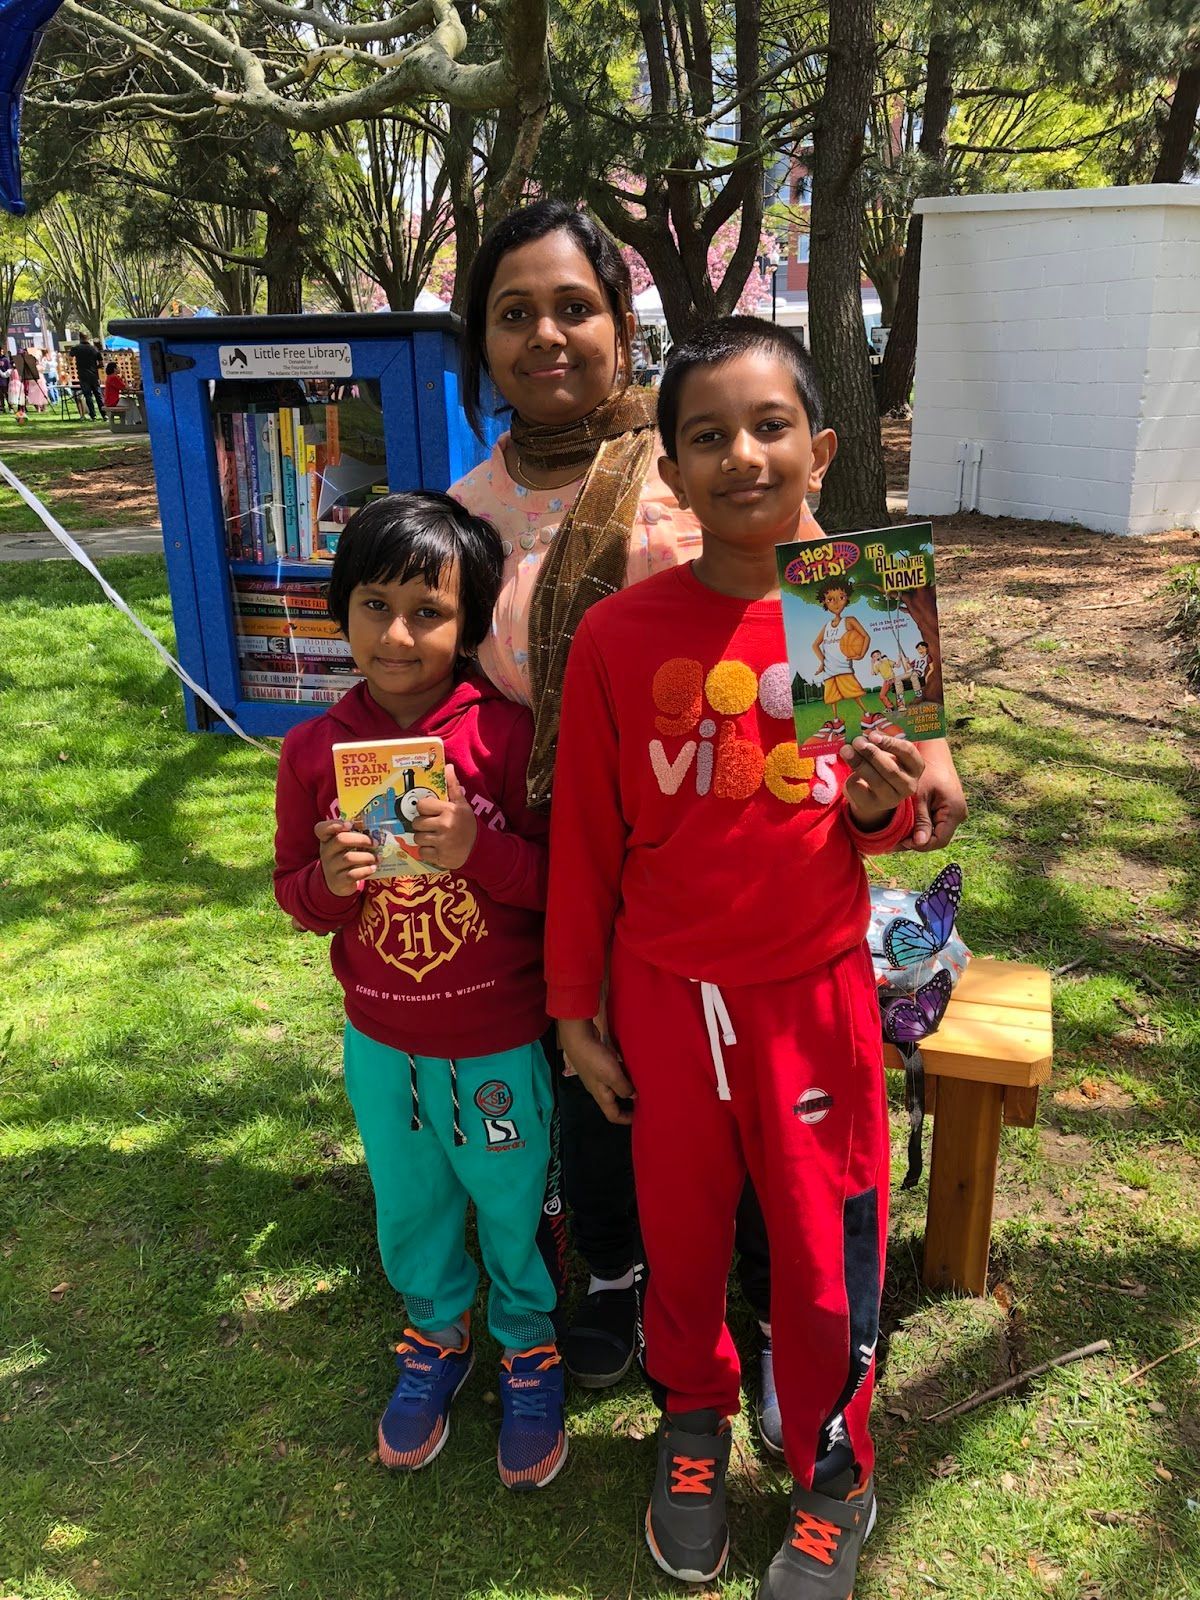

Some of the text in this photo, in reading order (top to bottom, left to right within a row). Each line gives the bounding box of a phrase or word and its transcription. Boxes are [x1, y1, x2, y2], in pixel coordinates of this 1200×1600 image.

[254, 347, 345, 361] Little Free Library
[800, 543, 834, 566] Hey
[866, 544, 884, 558] IT'S
[828, 558, 847, 577] D!
[875, 555, 924, 573] ALL IN THE
[885, 567, 925, 588] NAME
[295, 645, 349, 654] FIGURES
[915, 659, 926, 669] 12
[252, 687, 282, 698] COMMON
[311, 690, 335, 702] JULIUS
[341, 752, 377, 765] STOP,
[648, 718, 838, 805] vibes
[342, 763, 391, 776] TRAIN,
[344, 775, 383, 788] STOP!
[391, 911, 437, 961] H
[355, 984, 379, 998] SCHOOL
[381, 992, 390, 1000] OF
[392, 992, 441, 1002] WITCHCRAFT
